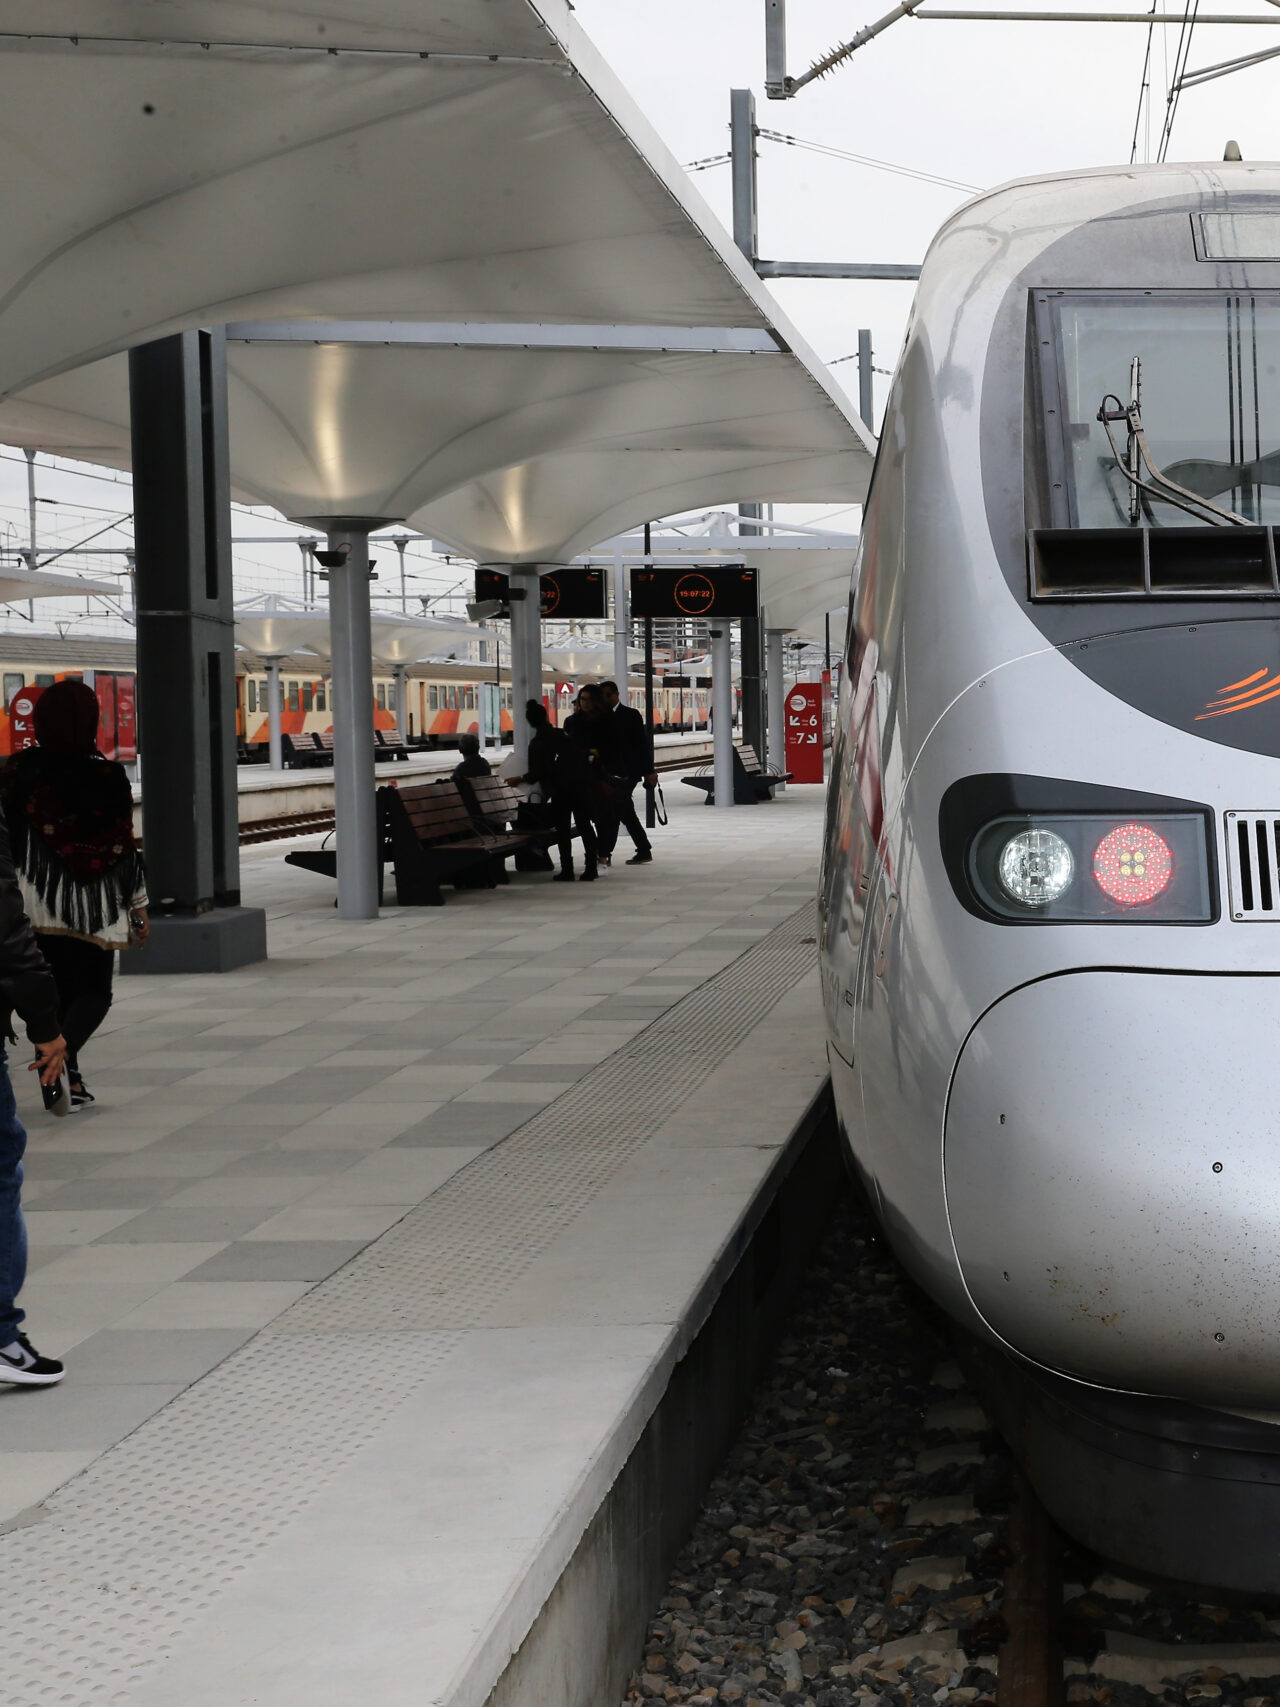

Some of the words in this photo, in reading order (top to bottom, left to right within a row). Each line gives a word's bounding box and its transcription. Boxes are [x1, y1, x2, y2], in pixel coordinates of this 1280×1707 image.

[561, 683, 570, 693] A
[809, 714, 818, 726] 6
[22, 737, 32, 749] 5
[796, 732, 805, 744] 7
